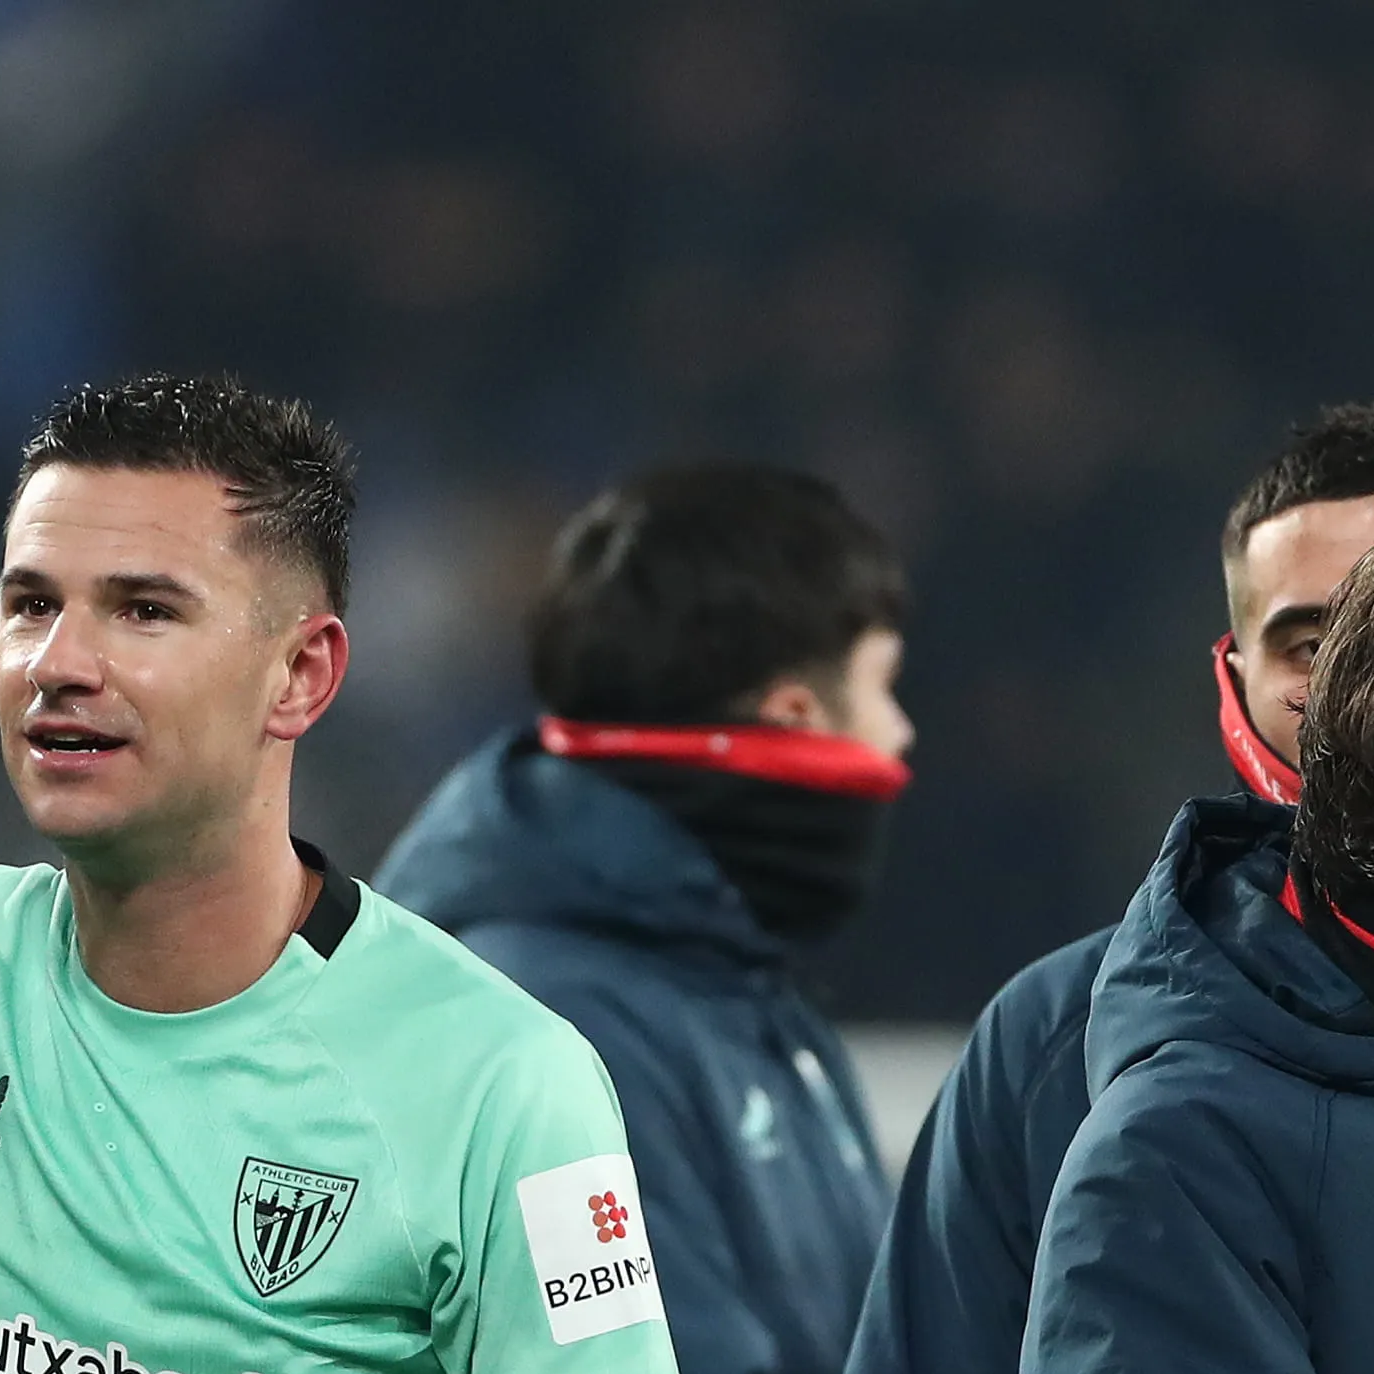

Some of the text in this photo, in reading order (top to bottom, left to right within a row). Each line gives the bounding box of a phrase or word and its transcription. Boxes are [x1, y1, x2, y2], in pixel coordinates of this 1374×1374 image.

[252, 1165, 348, 1193] ATHLETIC CLUB
[250, 1253, 300, 1290] BILBAO
